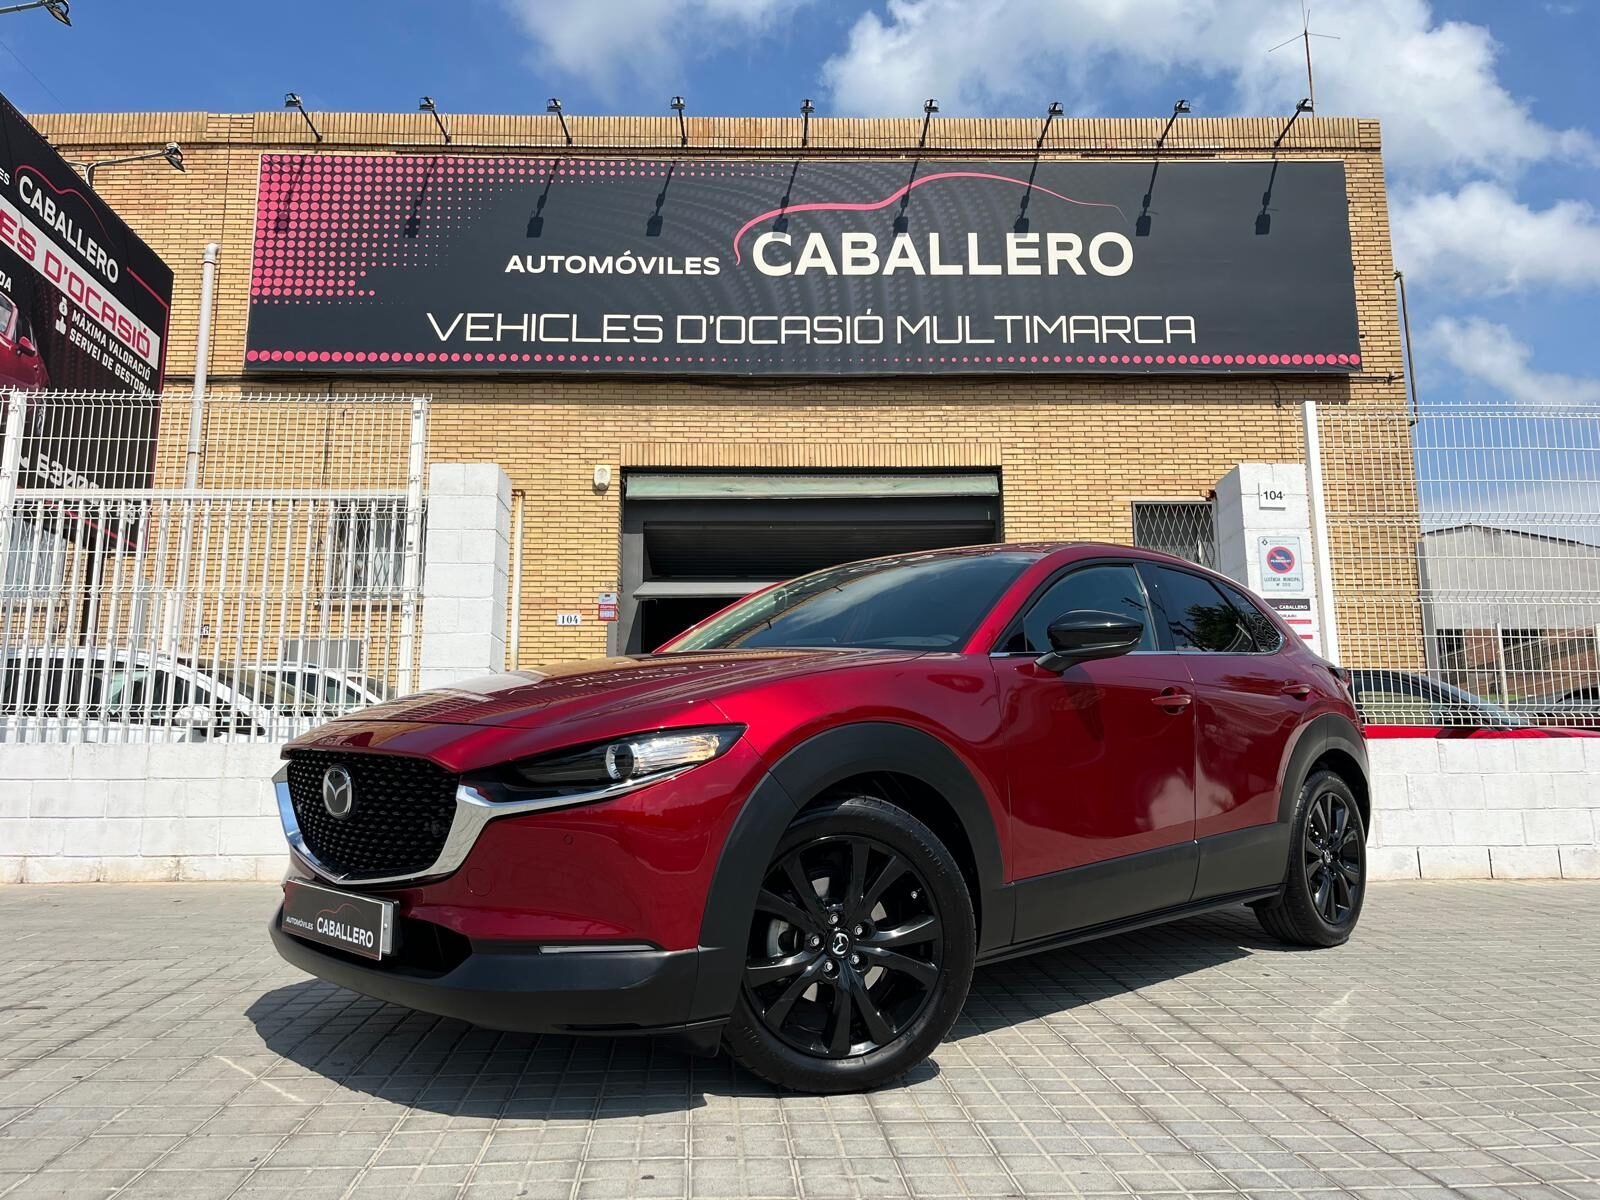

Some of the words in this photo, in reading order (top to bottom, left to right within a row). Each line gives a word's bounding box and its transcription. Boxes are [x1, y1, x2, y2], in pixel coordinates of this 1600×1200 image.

[19, 175, 119, 284] CABALLERO
[505, 250, 721, 276] AUTOMÓVILES
[752, 231, 1134, 277] CABALLERO
[43, 249, 150, 358] D'OCASIÓ
[71, 309, 107, 348] MÀXIMA
[109, 338, 151, 381] VALORACIÓ
[426, 312, 664, 343] VEHICLES
[676, 308, 884, 345] D'OCASIÓ
[897, 315, 1197, 345] MULTIMARCA
[69, 328, 101, 361] SERVEI
[101, 352, 114, 371] DE
[1263, 490, 1283, 501] 104
[561, 615, 578, 624] 104
[285, 916, 314, 931] AUTOMÓVILES
[317, 917, 374, 948] CABALLERO
